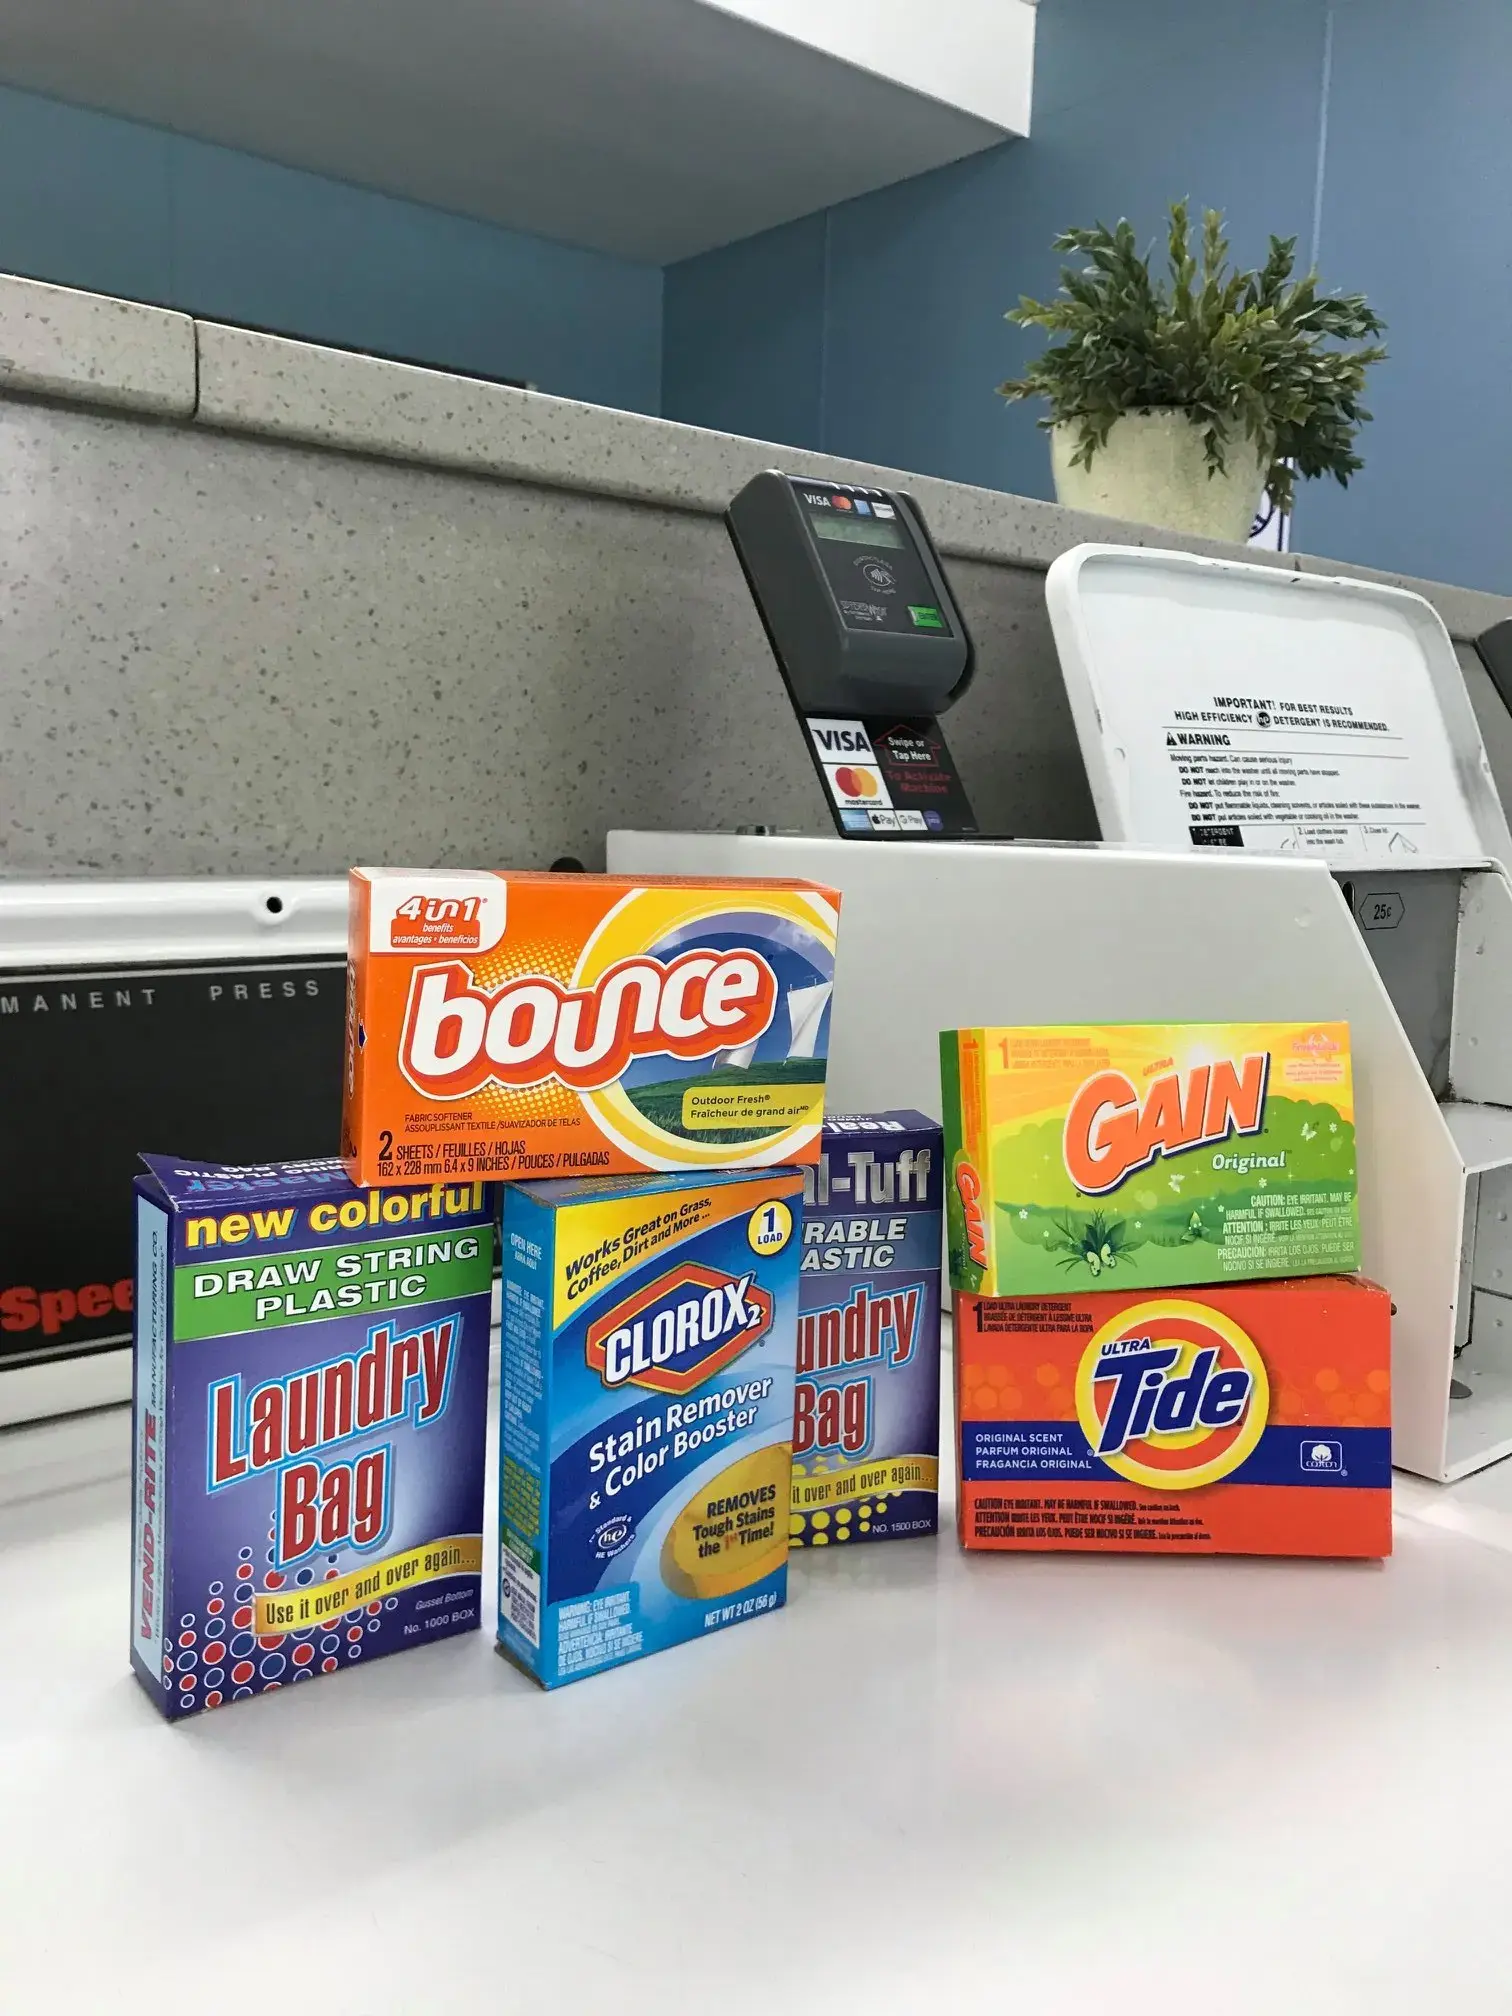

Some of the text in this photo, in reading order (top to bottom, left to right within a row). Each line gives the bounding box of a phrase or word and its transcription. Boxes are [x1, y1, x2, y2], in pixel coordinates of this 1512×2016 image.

[804, 493, 831, 507] VISA
[1213, 697, 1353, 715] IMPORTANT! FOR BEST RESULTS
[1174, 711, 1390, 731] HIGH EFFICIENCY DETERGENT IS RECOMMENDED.
[812, 730, 871, 752] VISA
[888, 736, 924, 748] Swipe or
[1177, 733, 1231, 745] WARNING
[893, 750, 931, 762] Tap Here
[885, 771, 901, 781] To
[880, 815, 896, 827] Pay
[908, 815, 923, 826] Pay
[1374, 904, 1392, 920] 25¢
[423, 922, 454, 933] benefits
[393, 934, 479, 945] avantages beneficios
[209, 979, 320, 1001] PRESS
[405, 952, 770, 1089] bounce
[998, 1038, 1009, 1069] 1
[1142, 1057, 1174, 1077] ULTRA
[691, 1108, 738, 1118] Fraîcheur
[741, 1108, 753, 1116] de
[756, 1107, 784, 1118] grand
[692, 1096, 735, 1106] Outdoor
[405, 1112, 472, 1122] FABRIC SOFTENER
[405, 1122, 466, 1133] ASSOUPLISSANT
[466, 1120, 496, 1131] TEXTILE
[548, 1118, 559, 1128] DE
[559, 1117, 581, 1127] TELAS
[1064, 1052, 1268, 1195] GAIN
[379, 1130, 526, 1161] 2 SHEETS FEUILLES HOJAS
[173, 1168, 278, 1180] PLASTIC
[377, 1151, 610, 1177] 162 x 228 mm 6.4 x 9 INCHES POUCES PULGADAS
[1211, 1152, 1287, 1175] Original
[1250, 1193, 1328, 1207] CAUTION: EYE IRRITANT.
[185, 1181, 485, 1250] new colorful
[762, 1207, 777, 1233] 1
[956, 1161, 988, 1270] GAIN
[1225, 1208, 1257, 1220] HARMFUL
[1265, 1206, 1306, 1219] SWALLOWED.
[757, 1232, 783, 1245] LOAD
[800, 1217, 908, 1244] RABLE
[1222, 1221, 1264, 1234] ATTENTION
[565, 1197, 712, 1282] Works Great on Grass,
[194, 1238, 480, 1299] DRAW STRING
[567, 1213, 700, 1302] Coffee, Dirt and More
[256, 1273, 427, 1321] PLASTIC
[973, 1302, 983, 1332] 1
[1100, 1336, 1151, 1357] ULTRA
[210, 1317, 457, 1488] Laundry
[1093, 1346, 1254, 1458] Tide
[589, 1377, 773, 1473] Stain Remover
[793, 1380, 869, 1454] Bag
[975, 1433, 1063, 1443] ORIGINAL SCENT
[588, 1492, 602, 1511] &
[605, 1446, 670, 1498] Color
[673, 1405, 758, 1460] Booster
[976, 1446, 1072, 1456] PARFUM ORIGINAL
[976, 1459, 1092, 1469] FRAGANCIA ORIGINAL
[793, 1464, 933, 1504] it over and over again...
[279, 1446, 388, 1567] Bag
[707, 1484, 776, 1519] REMOVES
[141, 1408, 158, 1641] VEND-RITE
[693, 1505, 775, 1543] Tough Stains
[872, 1518, 931, 1534] NO. 1500 BOX
[698, 1540, 720, 1558] the
[739, 1522, 774, 1548] Time!
[266, 1546, 476, 1625] Use it over and over again...
[416, 1588, 475, 1612] Gusset Bottom
[705, 1592, 778, 1628] NET WT 2 OZ (56 g)
[404, 1608, 475, 1635] No. 1000 BOX
